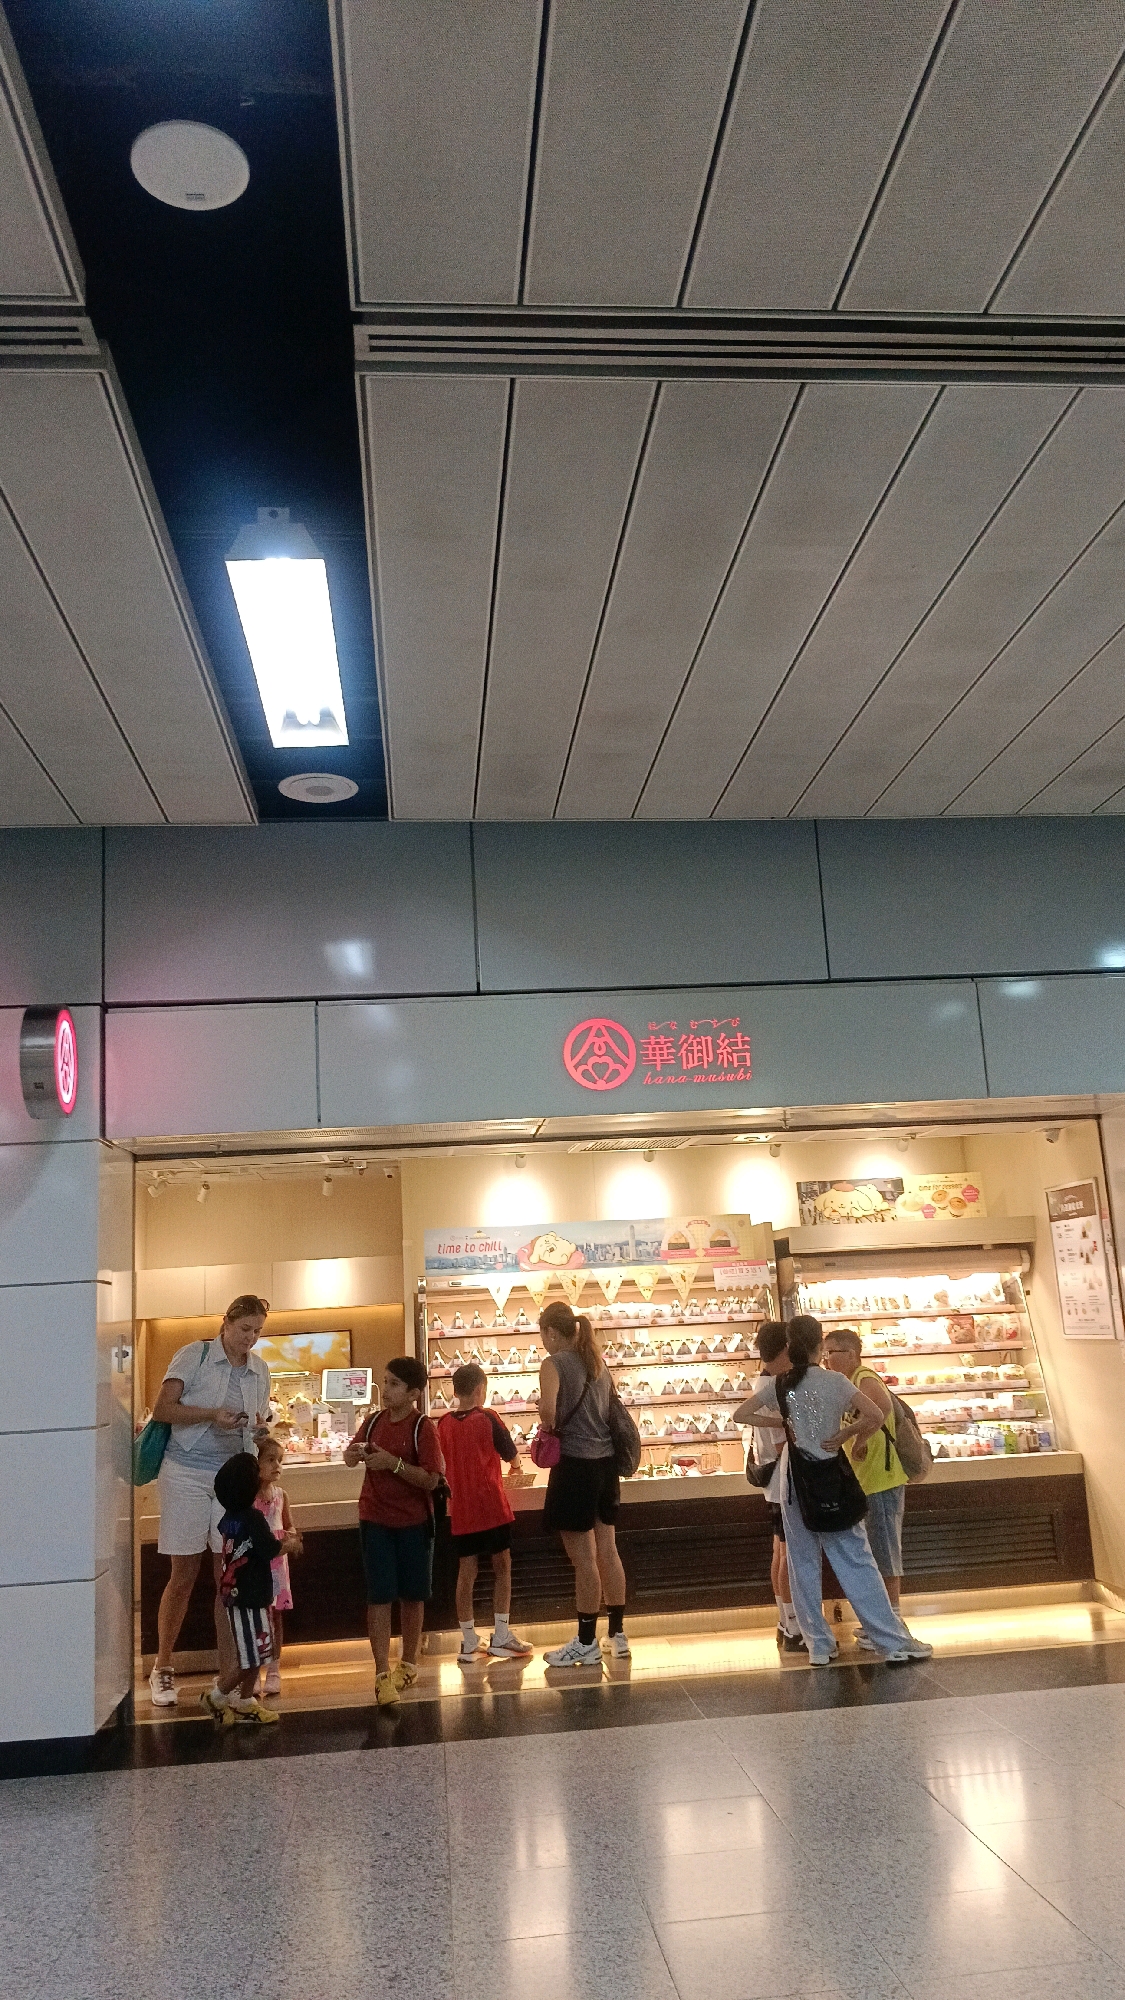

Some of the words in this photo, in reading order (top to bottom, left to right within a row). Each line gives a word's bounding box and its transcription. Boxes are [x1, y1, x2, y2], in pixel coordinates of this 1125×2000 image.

[639, 1032, 752, 1072] 華御結
[642, 1067, 753, 1085] hana-musubi
[437, 1243, 461, 1255] time
[464, 1242, 476, 1253] to
[478, 1240, 502, 1253] chill
